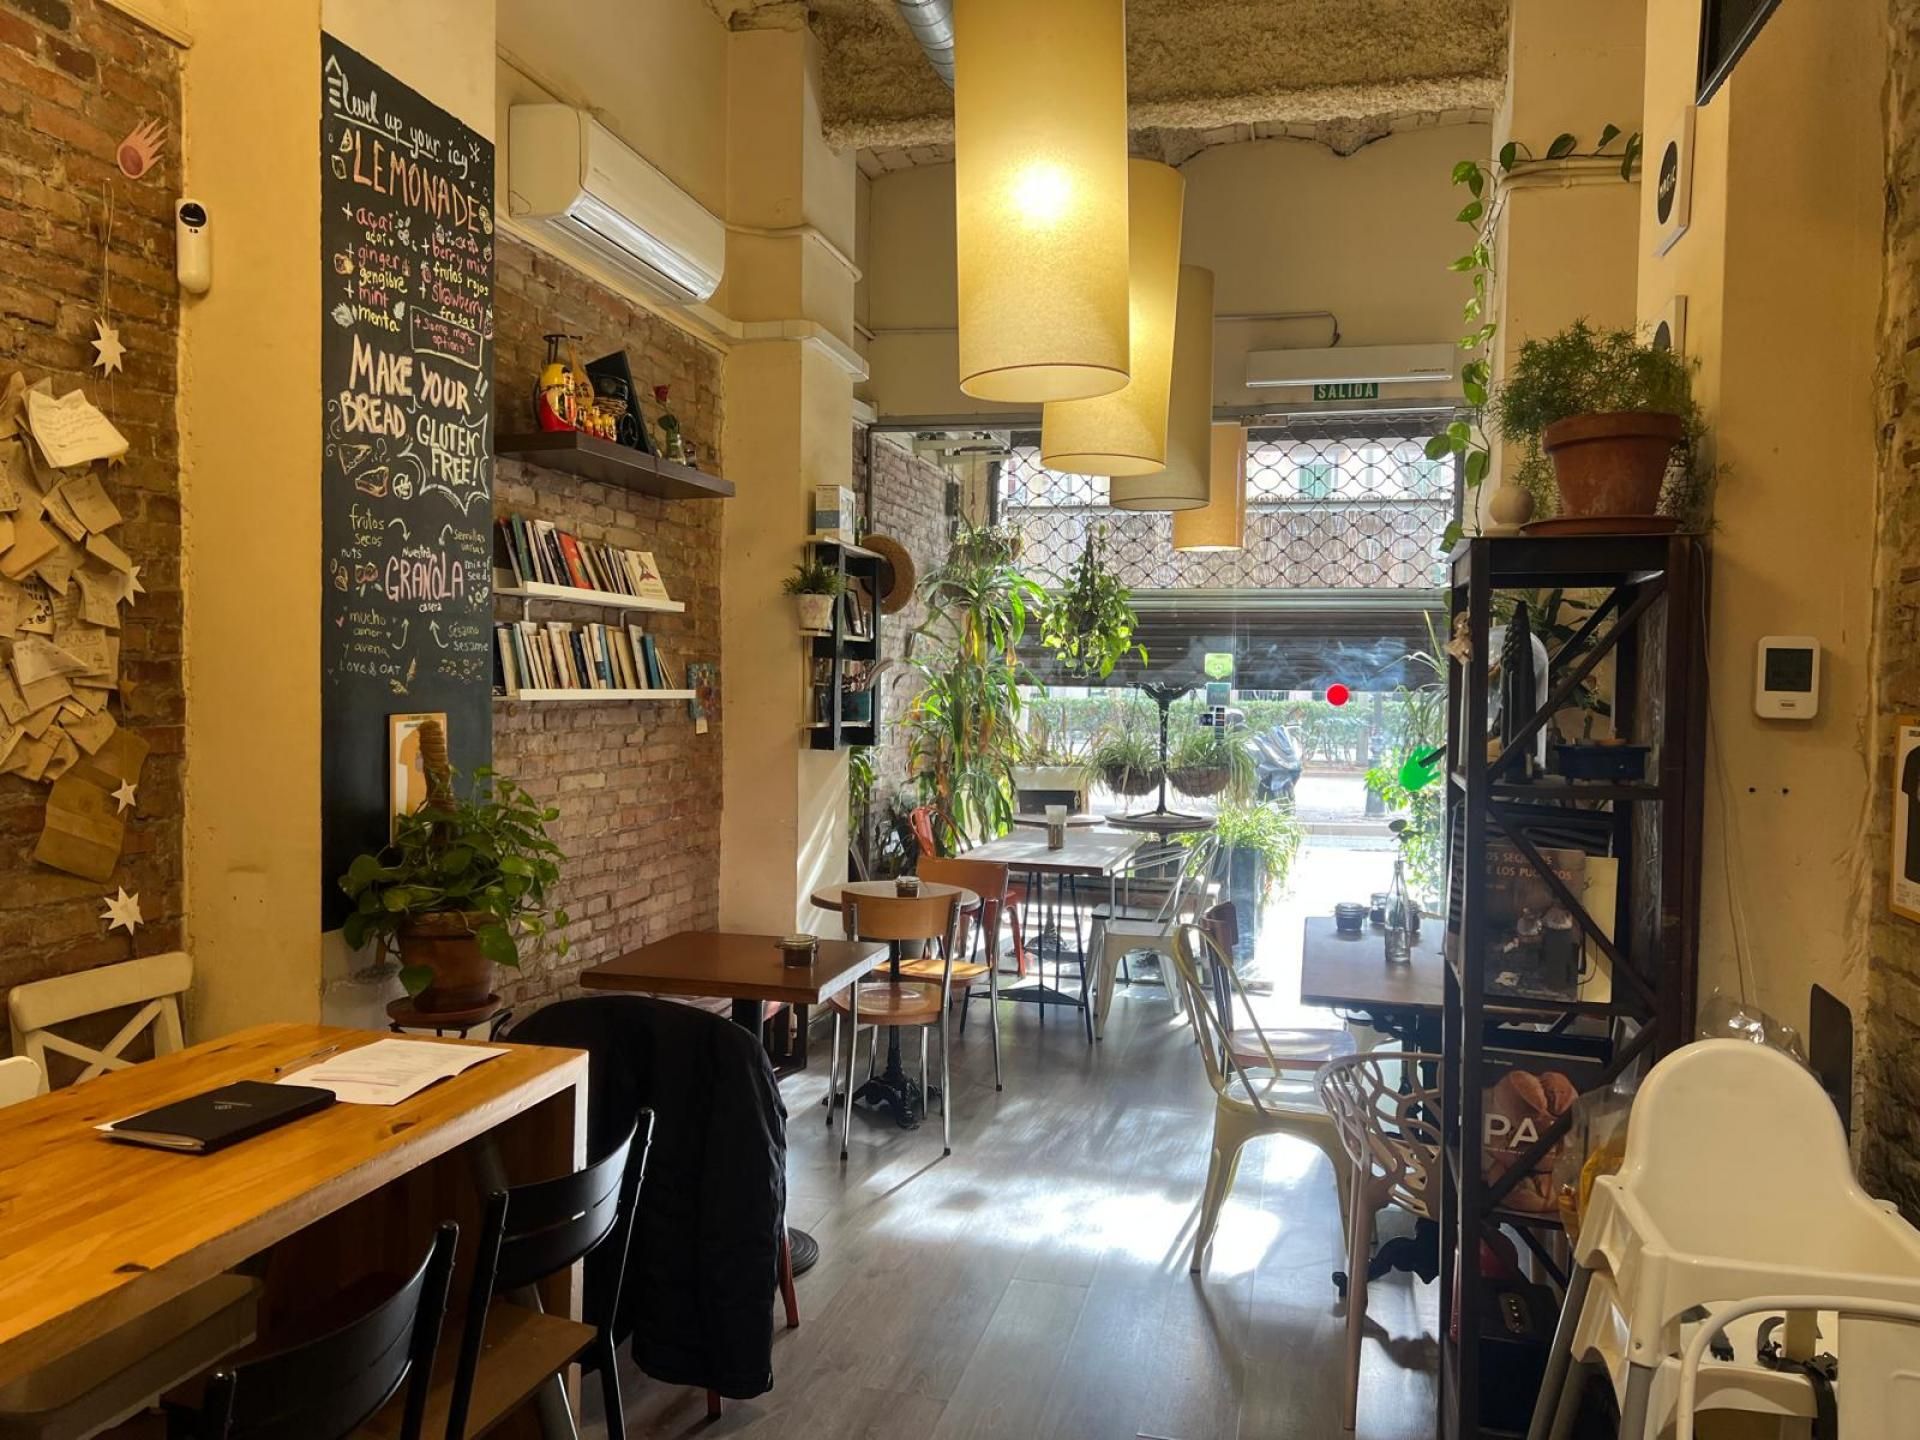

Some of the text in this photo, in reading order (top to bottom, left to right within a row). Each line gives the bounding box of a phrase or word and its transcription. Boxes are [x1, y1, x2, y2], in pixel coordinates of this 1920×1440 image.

[385, 112, 402, 144] up
[410, 127, 440, 159] your
[448, 140, 468, 180] icy
[354, 131, 480, 233] LEMONADE
[358, 243, 400, 271] ginger
[467, 258, 487, 277] mix
[359, 286, 389, 307] mint
[358, 304, 401, 332] menta
[350, 334, 412, 396] MAKE
[421, 361, 471, 415] YOUR
[1318, 384, 1374, 398] SALIDA
[340, 390, 406, 438] BREAD
[416, 414, 480, 456] GLUTEN
[385, 551, 464, 603] GRANOLA
[350, 608, 386, 626] mucho
[1497, 866, 1516, 876] LOS
